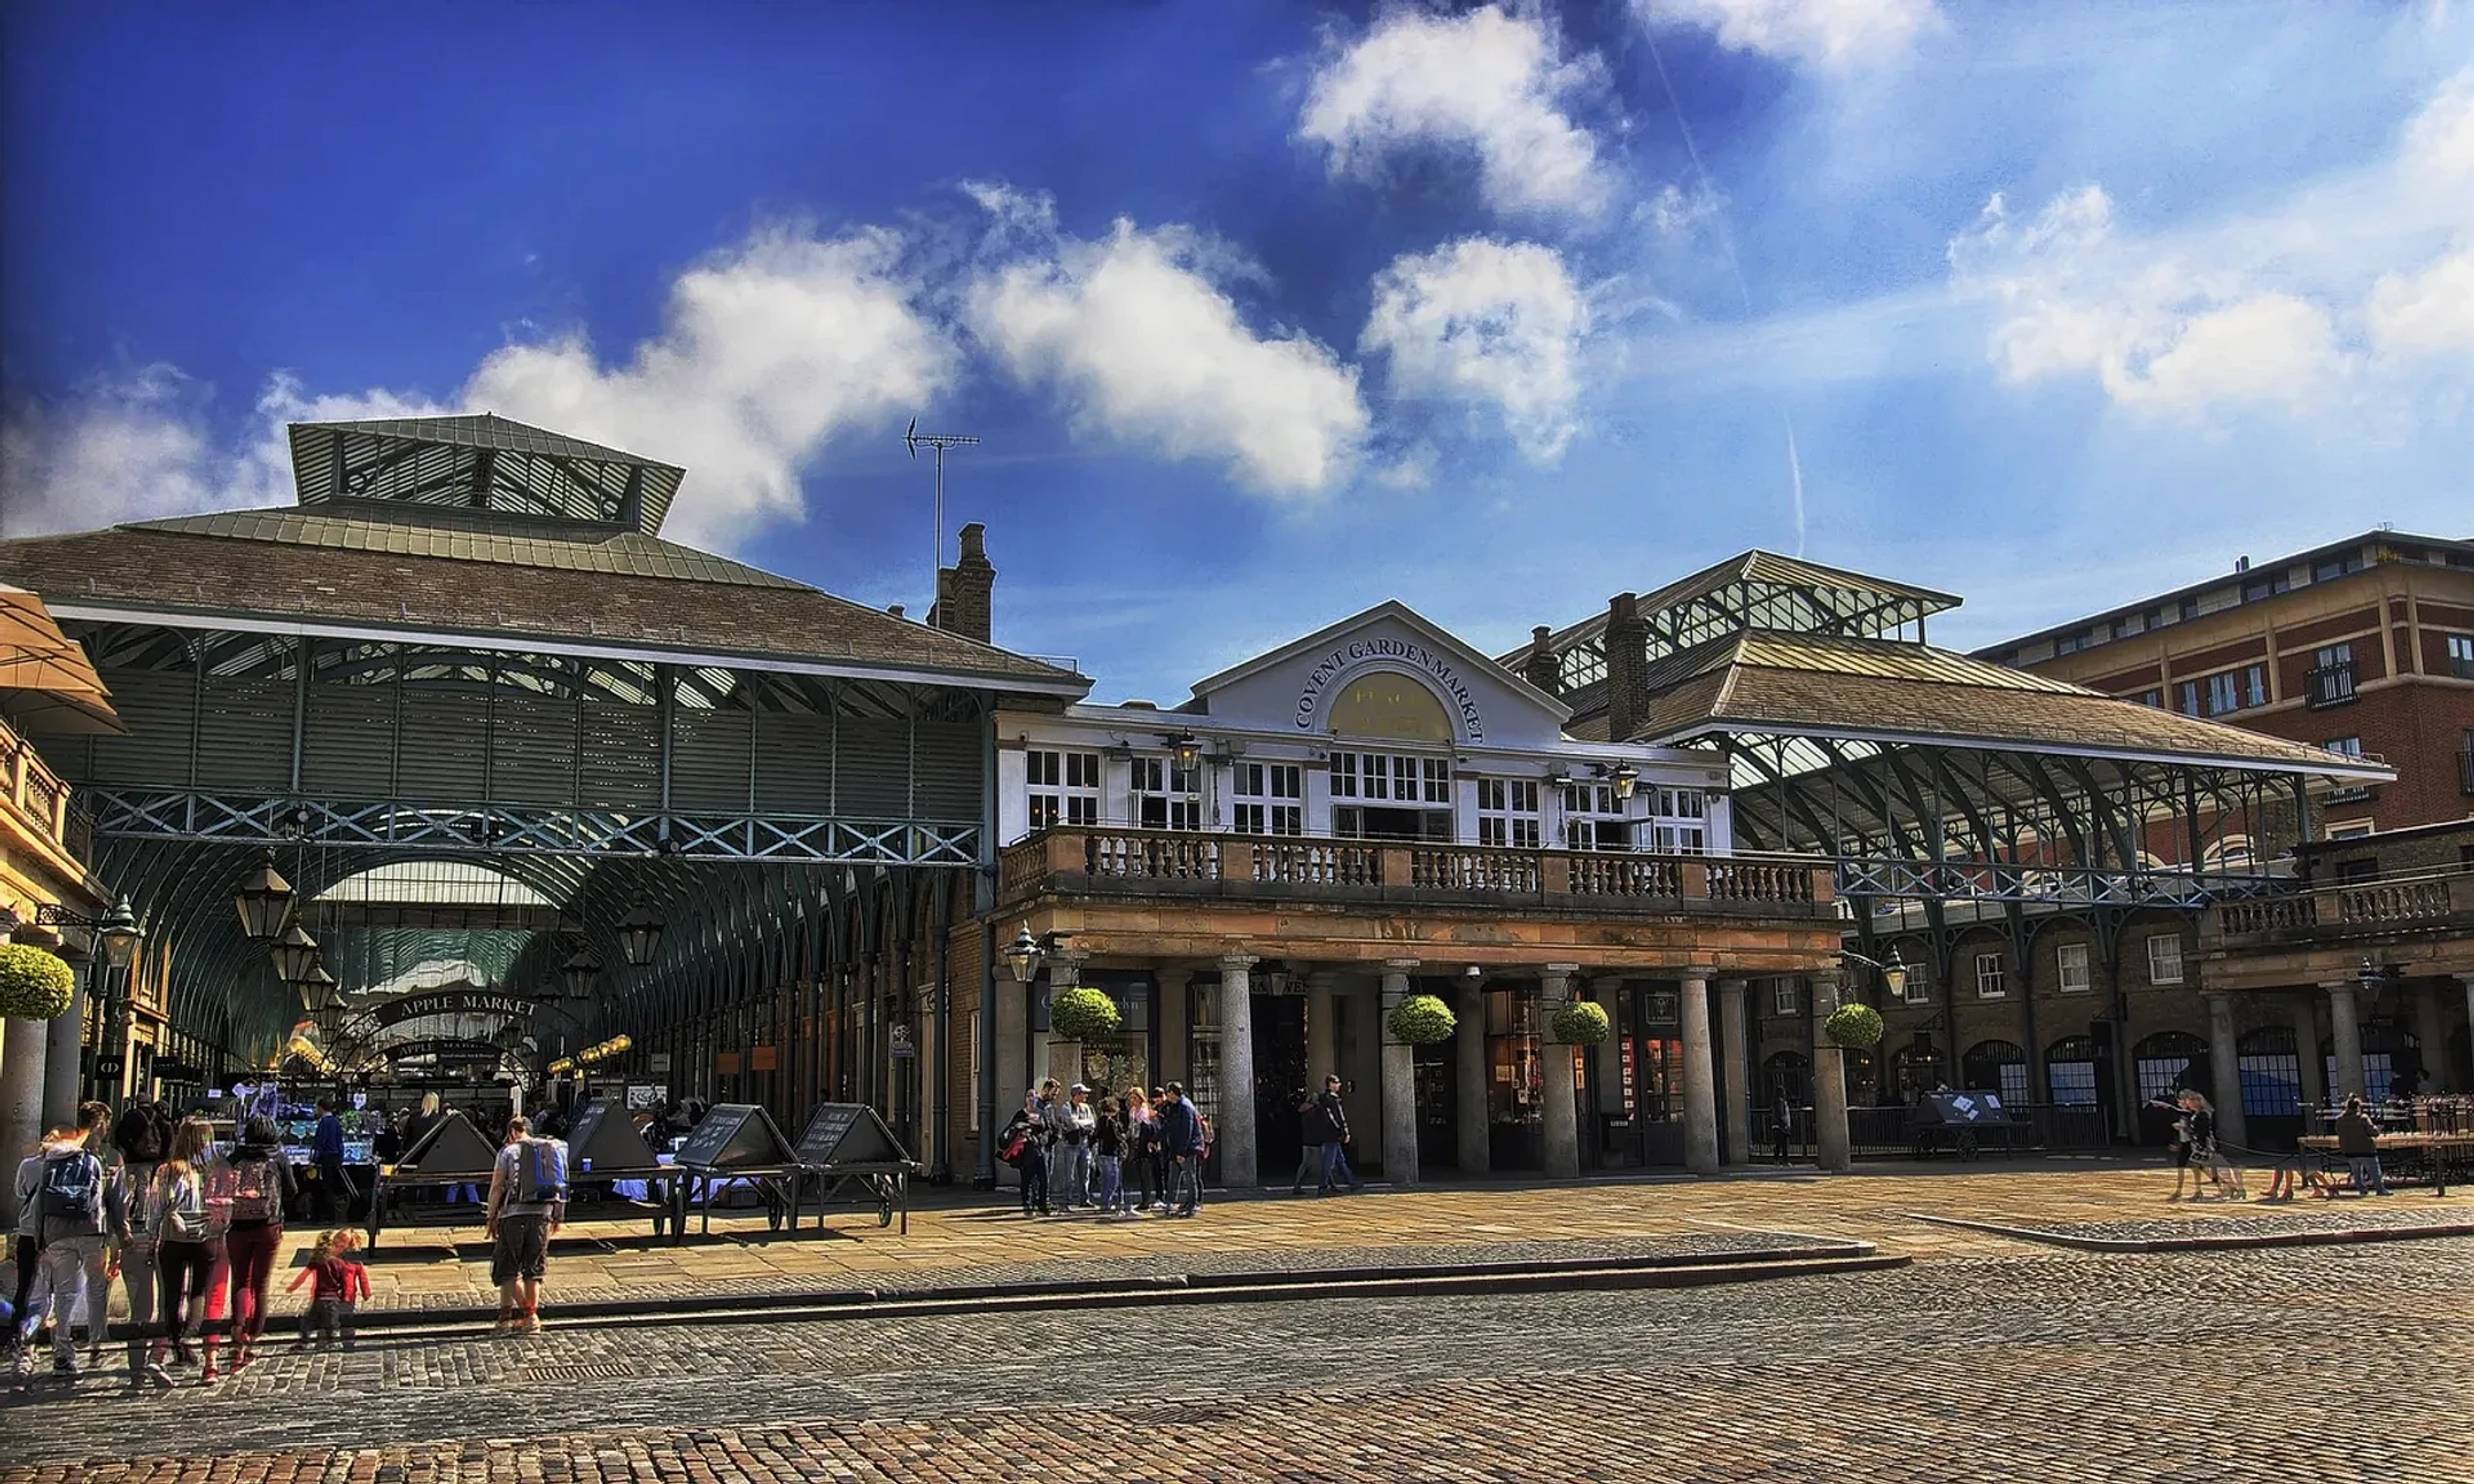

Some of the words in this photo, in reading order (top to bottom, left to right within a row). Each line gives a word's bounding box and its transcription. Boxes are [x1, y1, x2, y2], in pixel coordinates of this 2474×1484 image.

[1296, 650, 1345, 728] COVENT
[1348, 639, 1434, 668] GARDEN
[1432, 659, 1484, 743] MARKET
[401, 996, 453, 1016] APPLE
[463, 995, 537, 1016] MARKET
[399, 1042, 436, 1056] APPLE
